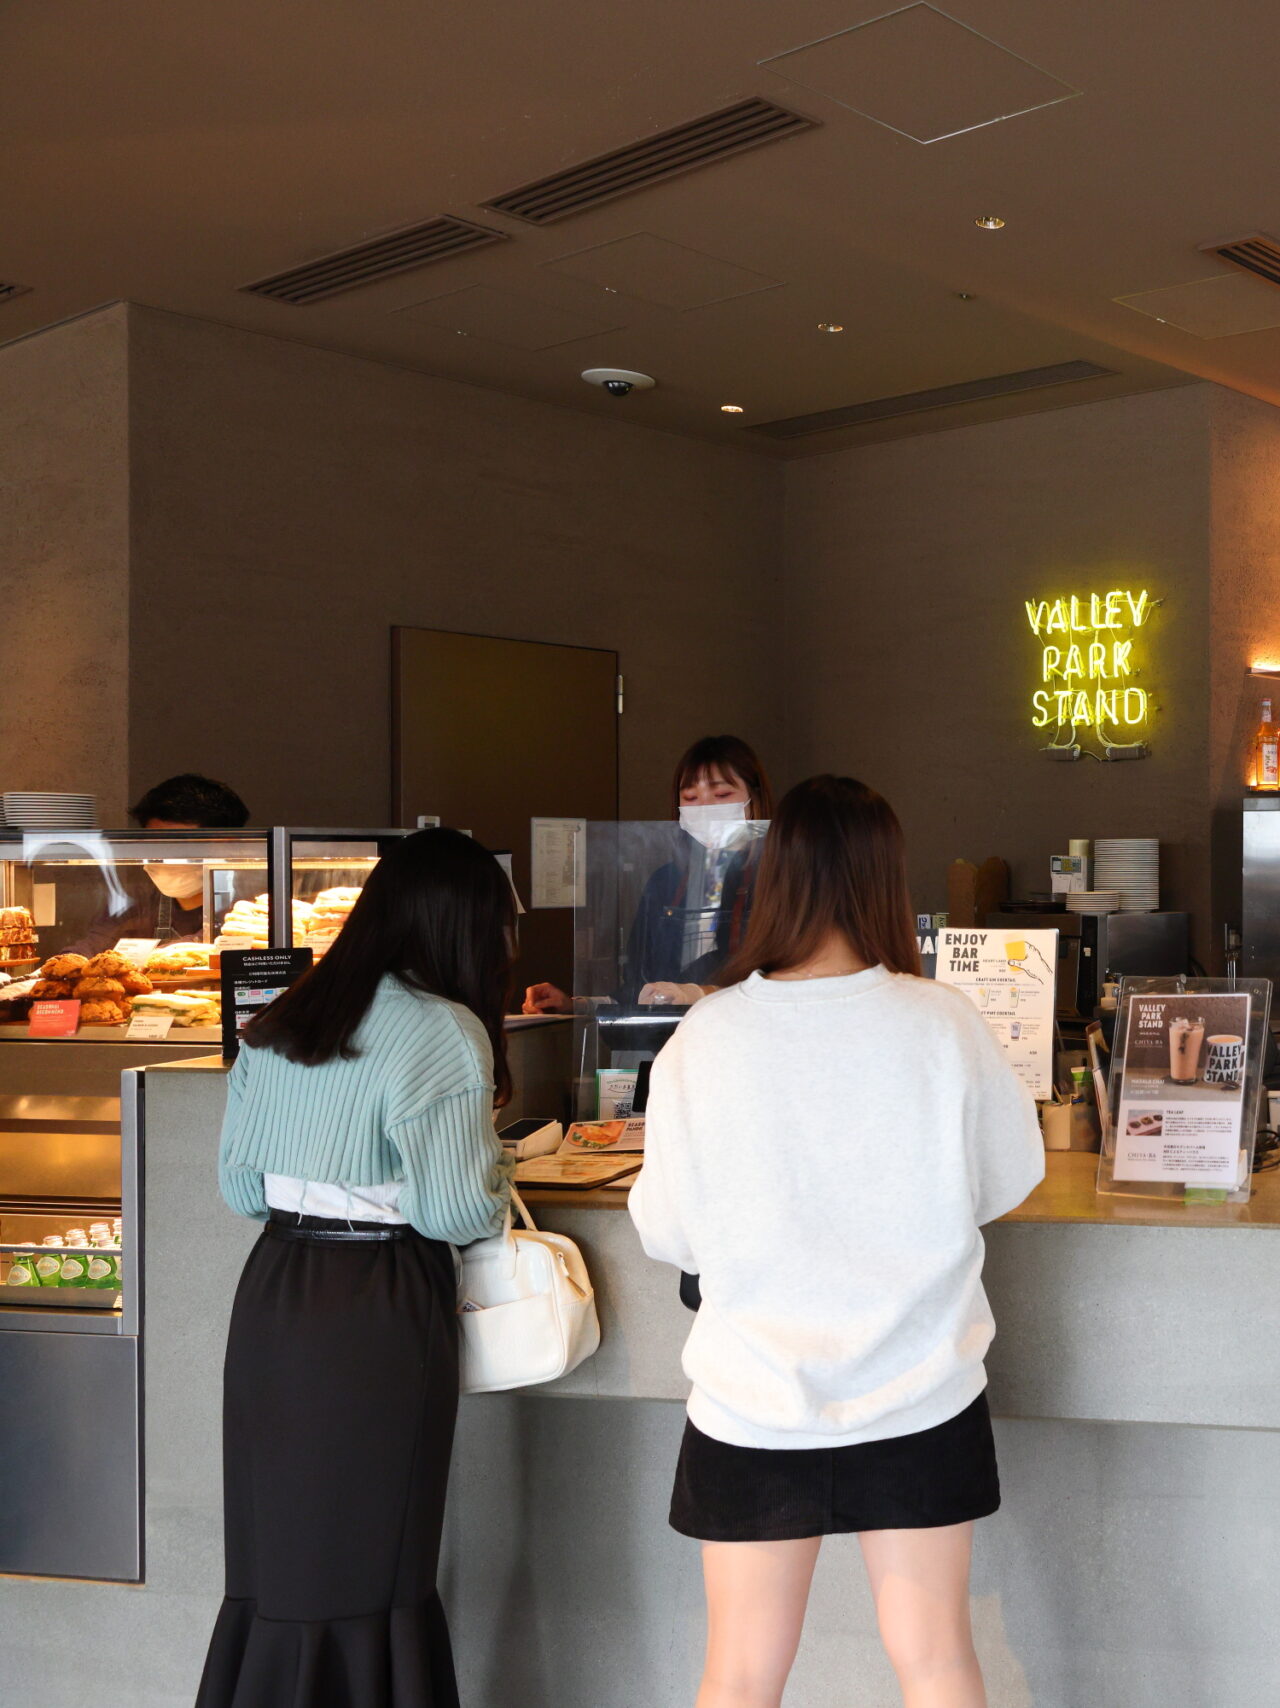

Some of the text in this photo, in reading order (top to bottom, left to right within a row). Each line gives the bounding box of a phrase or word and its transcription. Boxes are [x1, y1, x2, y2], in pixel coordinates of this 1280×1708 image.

[1025, 589, 1147, 635] VALLEY
[1043, 640, 1133, 682] PARK
[1032, 687, 1146, 727] STAND
[945, 933, 988, 945] ENJOY
[952, 947, 978, 959] BAR
[949, 960, 980, 972] TIME
[1139, 1004, 1166, 1012] VALLEY
[1141, 1012, 1162, 1020] PARK
[1138, 1020, 1163, 1028] STAND
[1207, 1044, 1241, 1058] VALLEY
[1208, 1058, 1238, 1070] PARK
[1206, 1070, 1239, 1082] STAND
